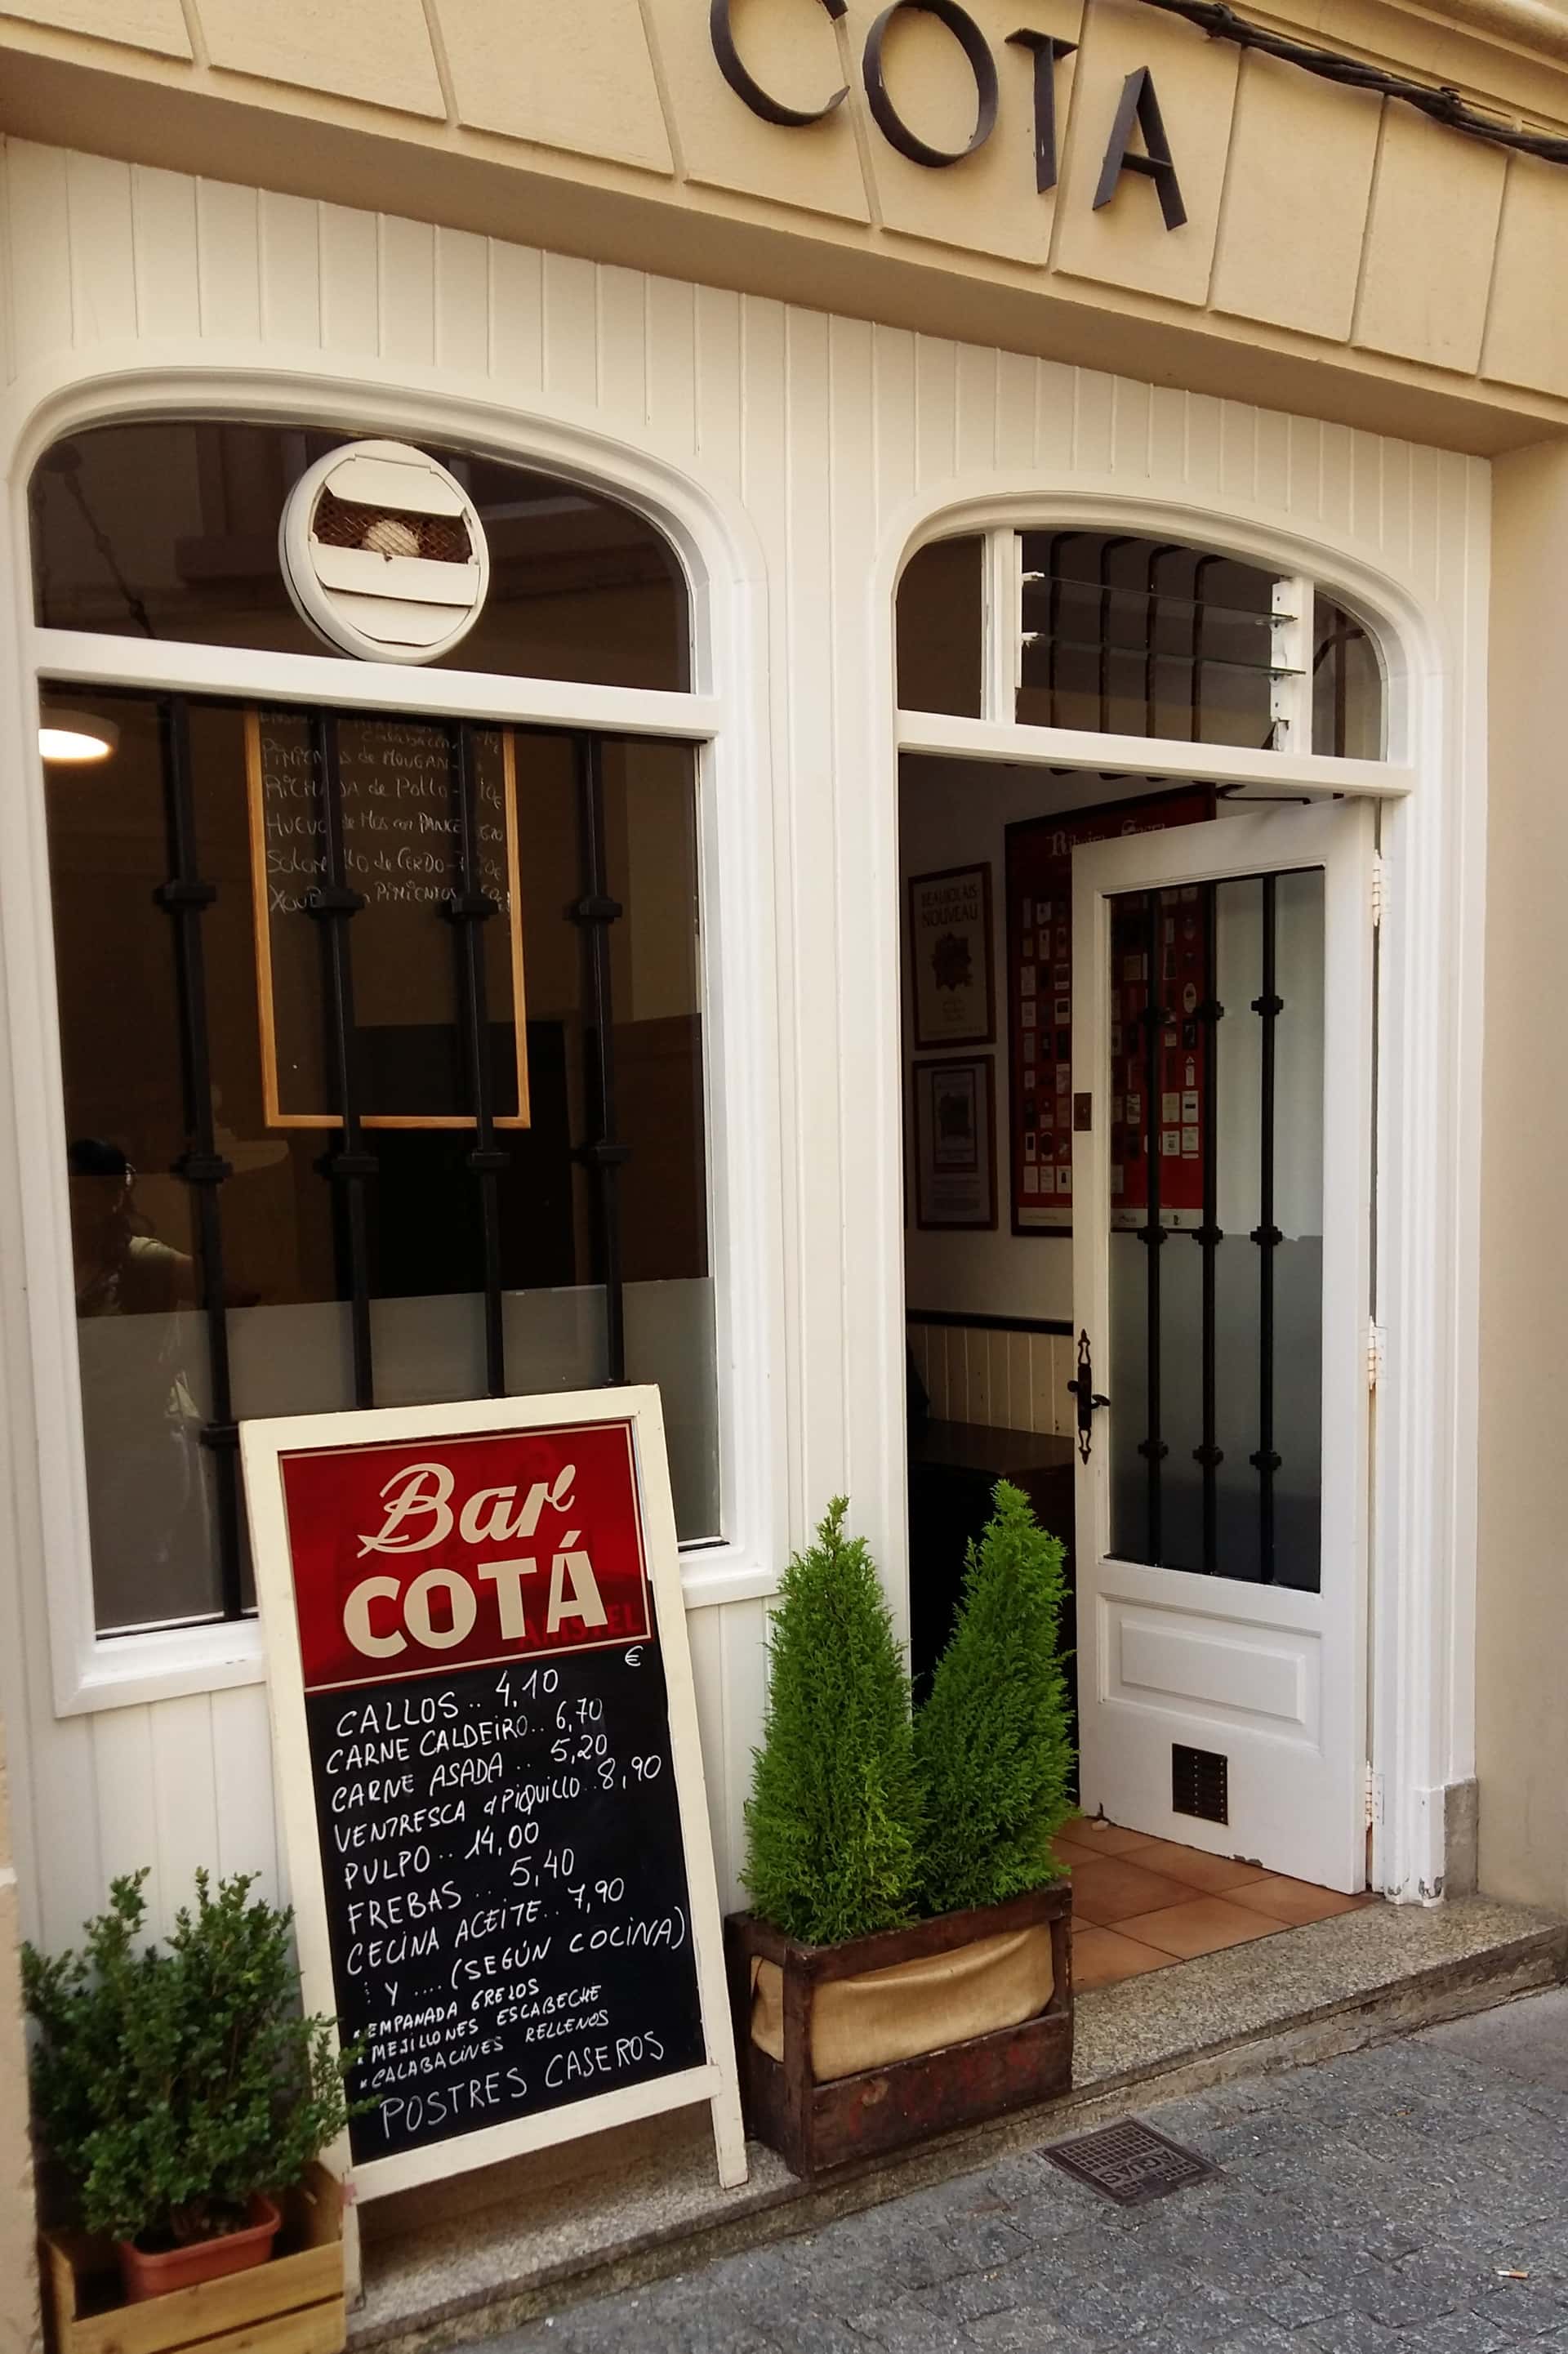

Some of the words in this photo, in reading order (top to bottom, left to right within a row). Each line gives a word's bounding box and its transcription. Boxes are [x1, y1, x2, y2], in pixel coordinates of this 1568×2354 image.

[709, 0, 1187, 232] COTA
[356, 1462, 576, 1558] Bar
[343, 1530, 608, 1659] COTÁ
[625, 1645, 644, 1667] €
[327, 1738, 410, 1774] CARNE
[332, 1774, 414, 1812] CARNE
[429, 1752, 503, 1796] ASADA
[334, 1800, 466, 1852] VENTRESCA
[497, 1984, 602, 2026] ESCABECHE
[525, 2008, 609, 2043] RELLENOS
[380, 2067, 528, 2139] POSTRES
[545, 2031, 664, 2088] CASEROS
